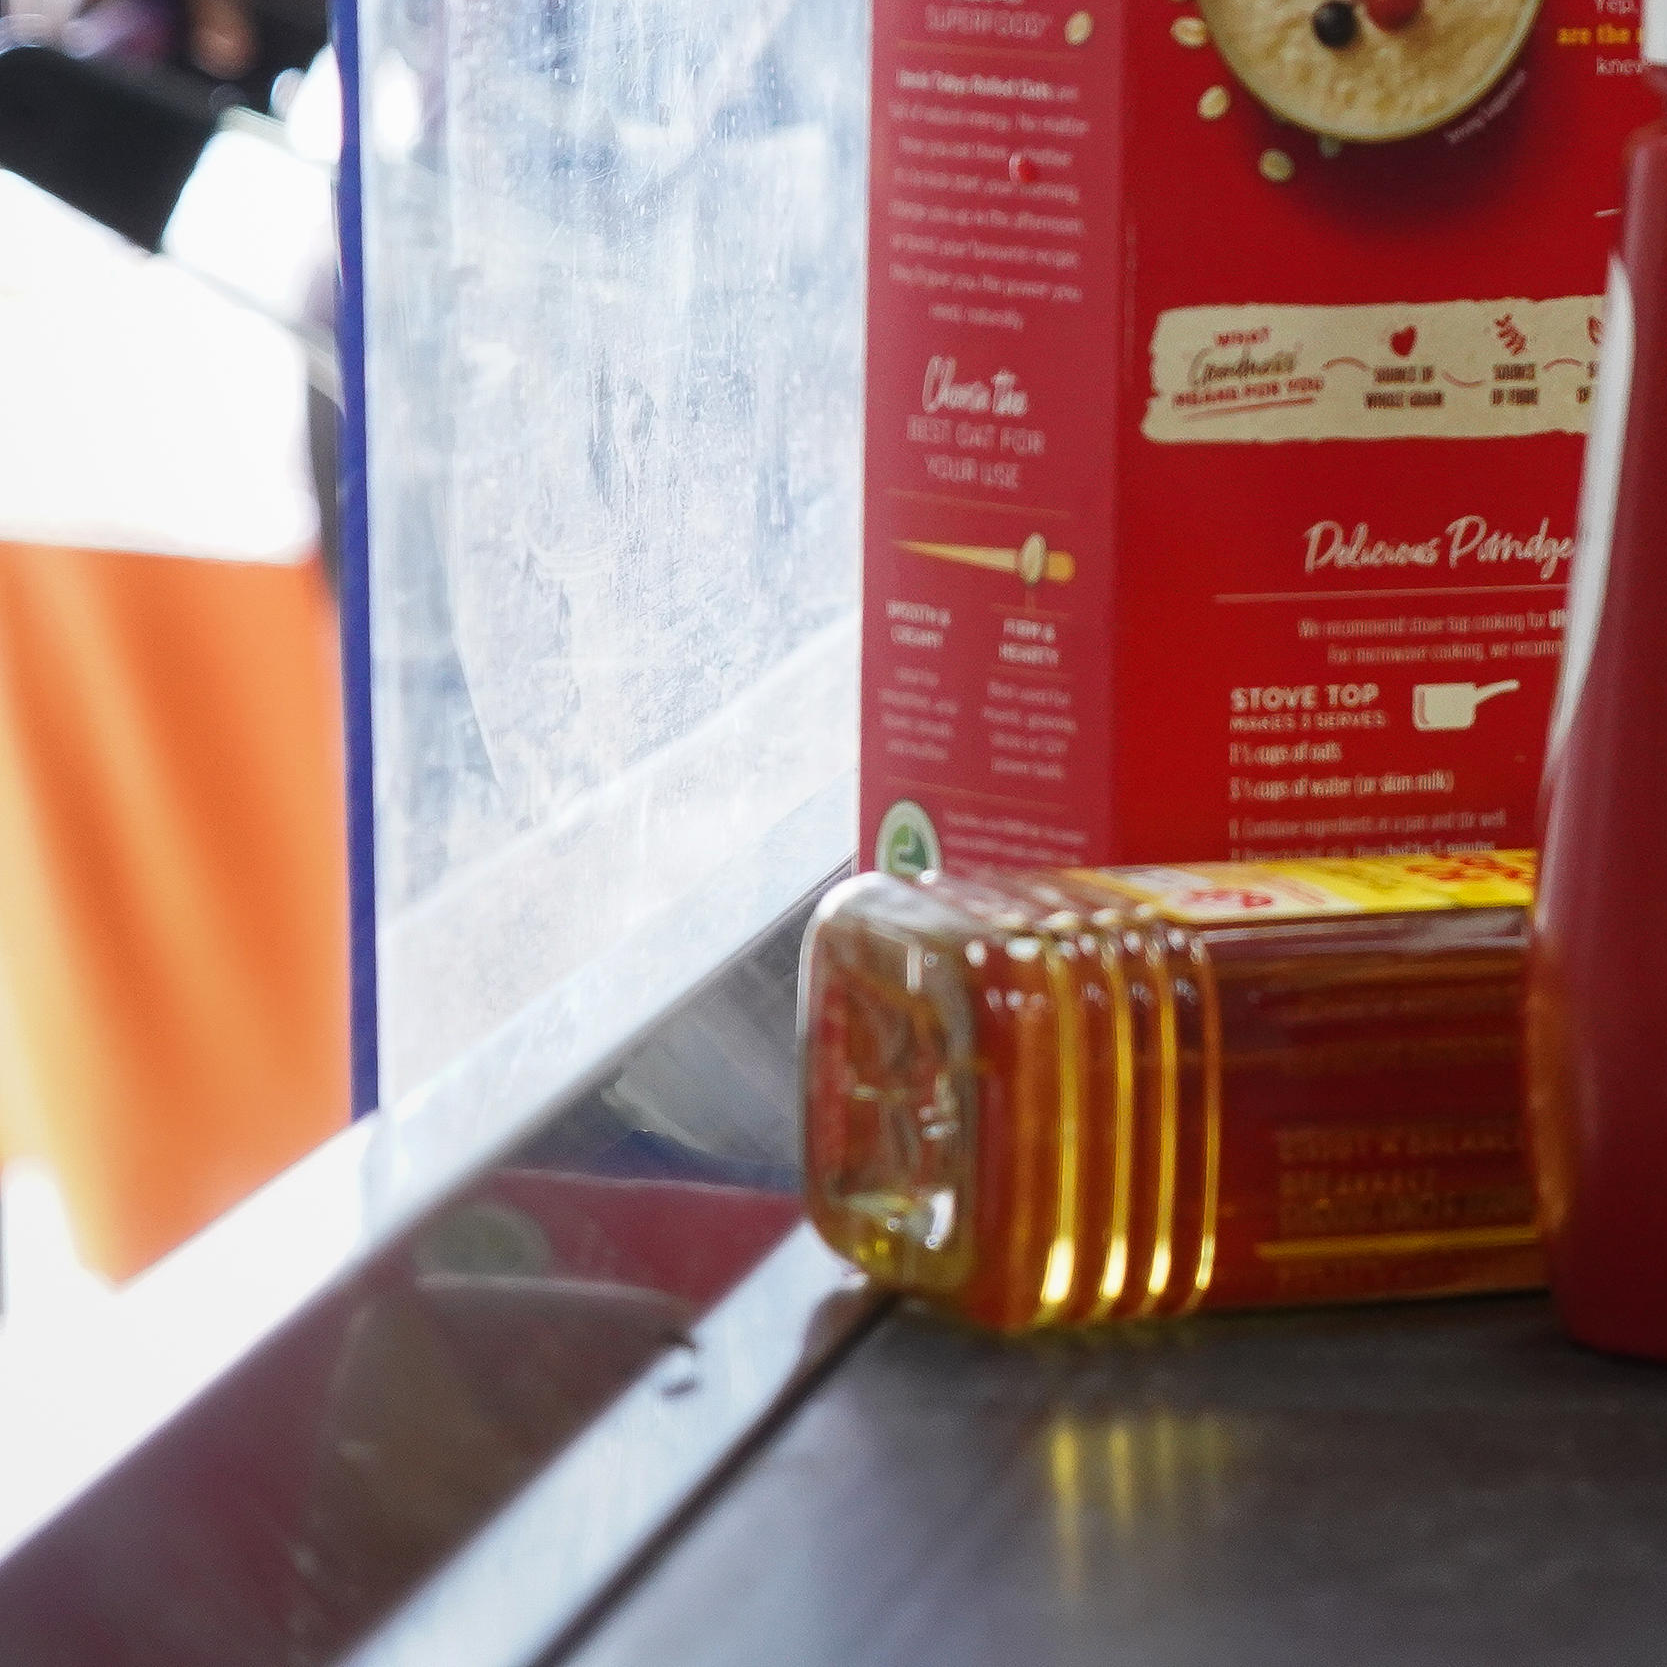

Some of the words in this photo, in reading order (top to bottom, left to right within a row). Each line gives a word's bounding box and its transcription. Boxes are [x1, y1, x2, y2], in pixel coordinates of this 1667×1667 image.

[1557, 27, 1591, 45] are
[1596, 24, 1631, 44] the
[999, 426, 1047, 457] FOR
[1444, 514, 1577, 581] Porridge
[1230, 685, 1318, 712] STOVE
[1325, 682, 1379, 706] TOP
[1229, 713, 1296, 733] MAKES
[1315, 710, 1388, 730] SERVES
